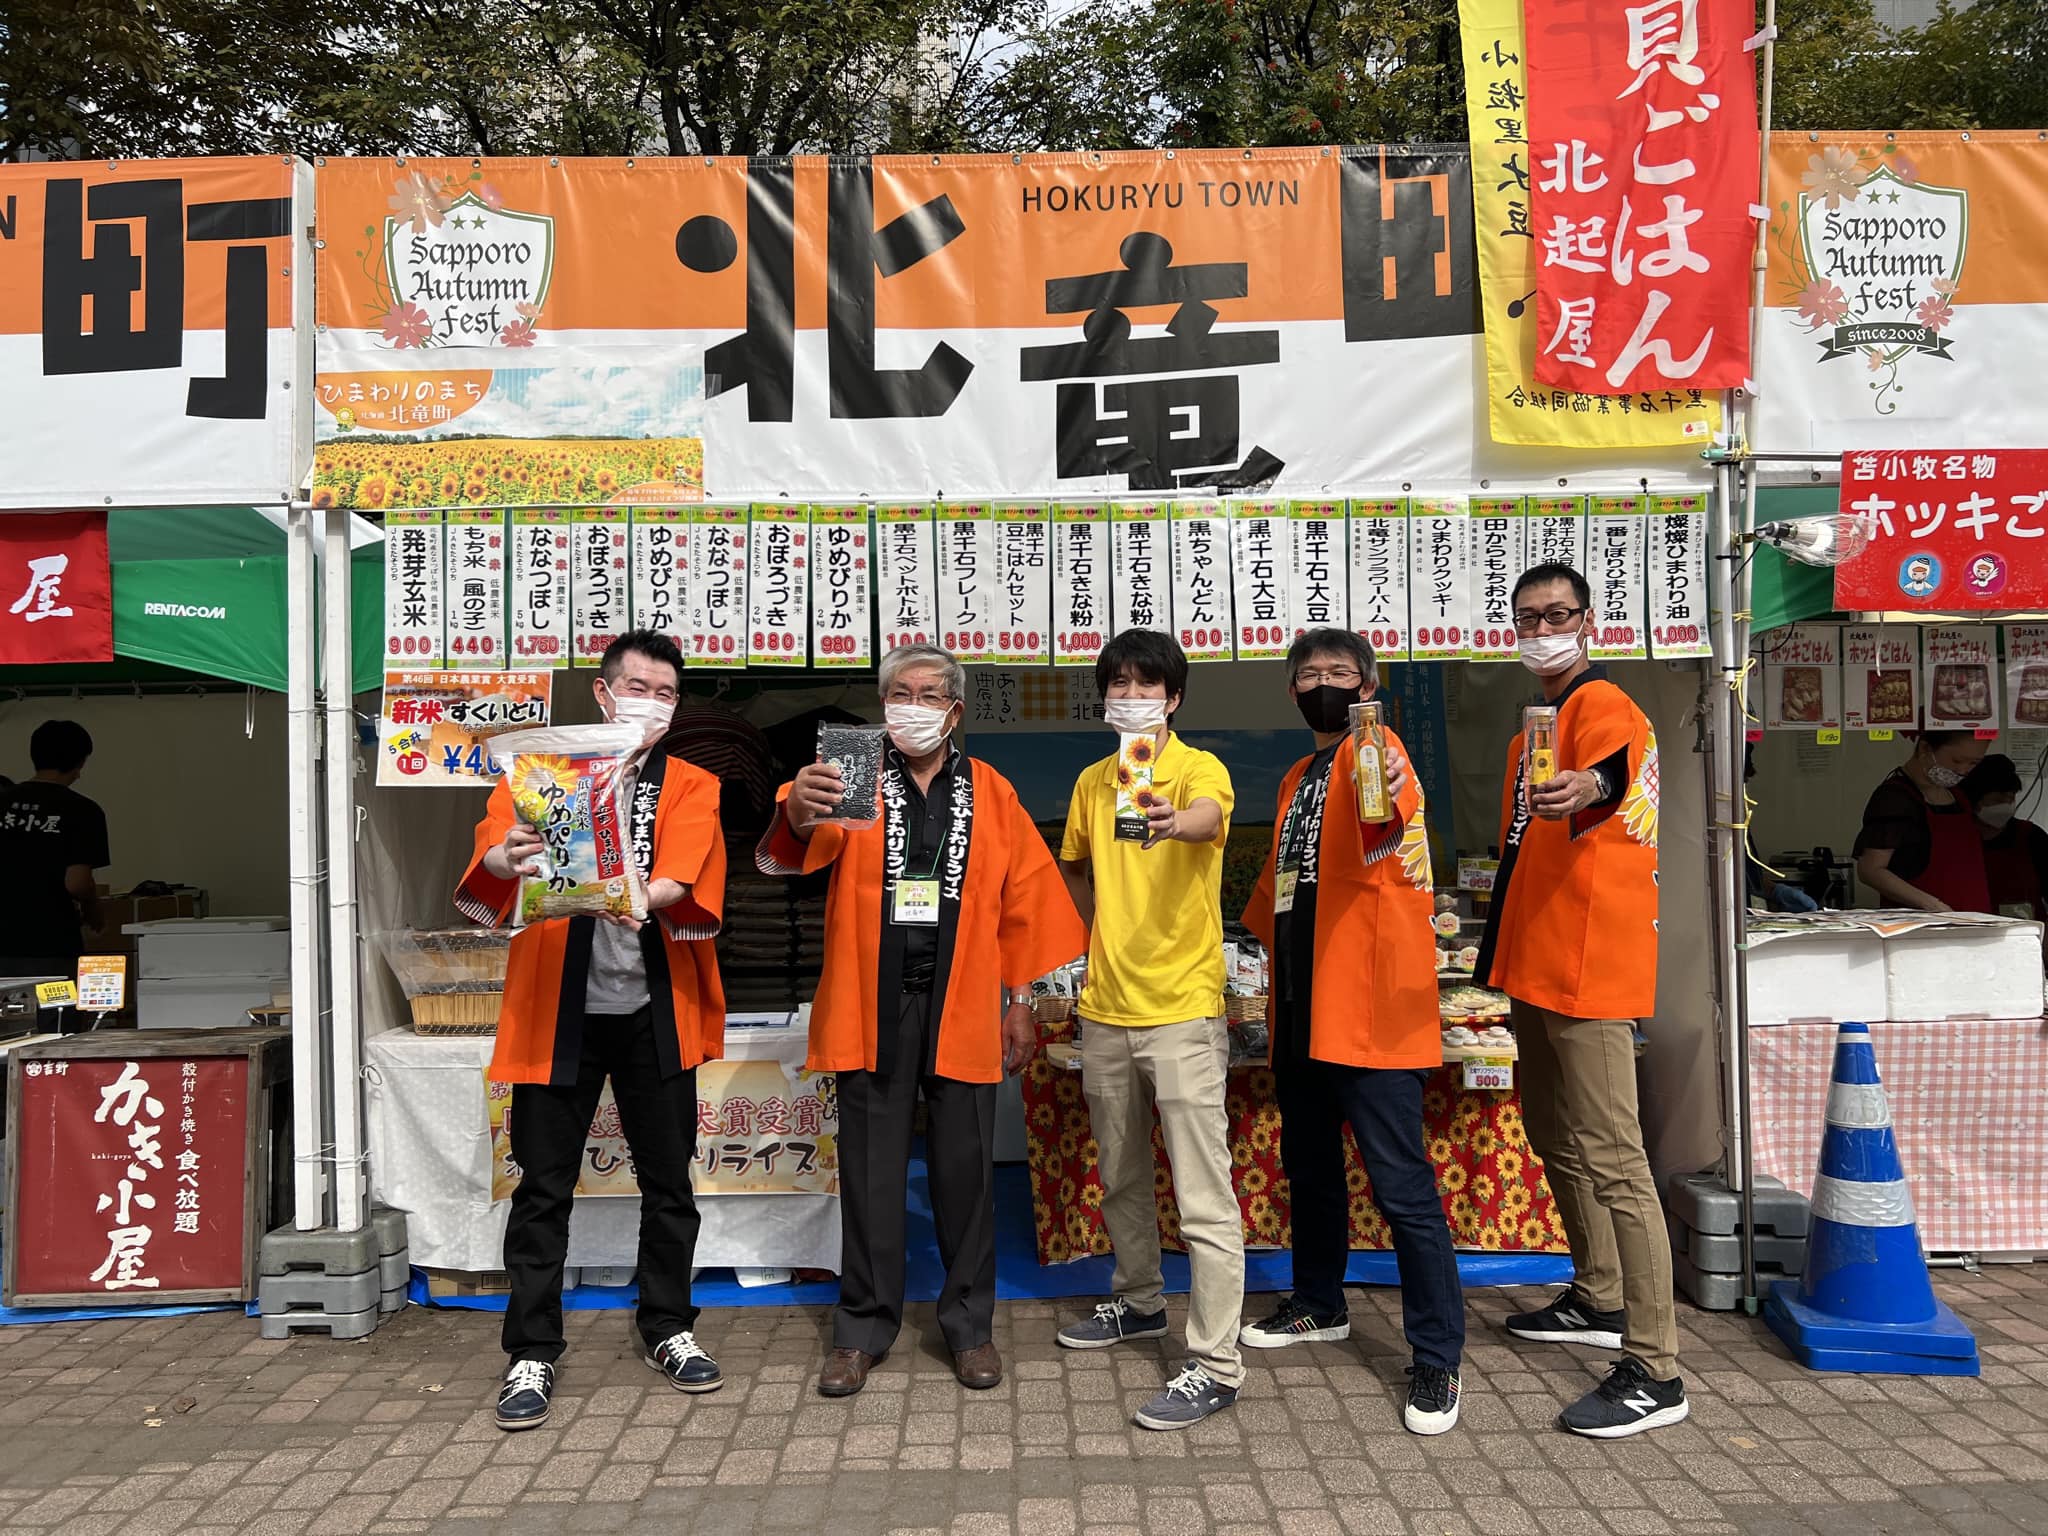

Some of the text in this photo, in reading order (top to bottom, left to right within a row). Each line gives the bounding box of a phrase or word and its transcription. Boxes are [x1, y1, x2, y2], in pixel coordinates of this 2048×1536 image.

[1022, 180, 1300, 213] HOKURYU TOWN
[1822, 212, 1947, 248] Sapporo
[407, 235, 532, 275] Sapporo
[1539, 139, 1608, 369] 北起屋
[1825, 247, 1947, 279] Autumn
[42, 178, 291, 420] 町
[408, 269, 531, 304] Autumn
[1847, 326, 1927, 342] since2008
[324, 379, 482, 402] ひまわりのまち
[390, 404, 453, 425] 北竜町
[1852, 454, 1997, 481] 苫小牧名物
[1850, 490, 2048, 541] ホッキご
[463, 526, 487, 569] もち米
[1025, 522, 1045, 567] 黒千石
[9, 553, 73, 622] 屋
[402, 528, 428, 628] 発芽玄米
[529, 526, 552, 630] ななつぼし
[587, 525, 612, 629] おぼろづき
[649, 525, 673, 630] ゆめぴりか
[706, 525, 731, 629] ななつぼし
[766, 523, 791, 628] おぼろづき
[828, 525, 852, 630] ゆめぴりか
[953, 521, 977, 626] 黒千石フレーク
[1006, 522, 1025, 627] 豆ごはんセット
[1069, 523, 1094, 628] 黒千石きな粉
[1128, 521, 1154, 626] 黒千石きな粉
[1187, 520, 1214, 624] 黒ちゃんどん
[1248, 519, 1277, 621] 黒千石大豆
[1305, 520, 1331, 623] 黒千石大豆
[1431, 518, 1453, 618] ひまわりクッキー
[1484, 518, 1508, 624] 田からもちおかき
[1603, 519, 1629, 622] 一番しぼりひまわり油
[1664, 514, 1691, 620] 燦燦ひまわり油
[144, 602, 226, 619] RENTACOM
[388, 635, 433, 655] 900
[451, 635, 494, 655] 440
[693, 634, 736, 654] 780
[753, 632, 796, 651] 880
[820, 635, 857, 655] 980
[944, 631, 986, 650] 350
[999, 630, 1040, 650] 500
[1059, 631, 1102, 653] 1,000
[1180, 628, 1223, 649] 500
[1241, 625, 1283, 646] 500
[1417, 625, 1461, 647] 900
[1473, 628, 1516, 648] 300
[1591, 625, 1636, 648] 1,000
[1653, 624, 1699, 647] 1,000
[391, 699, 546, 725] 新米 すくいとり
[997, 672, 1016, 724] あかるい
[400, 758, 424, 770] 1回
[0, 811, 62, 835] き小屋
[539, 781, 578, 894] ゆめぴりか
[1475, 1074, 1500, 1087] 500
[173, 1062, 202, 1234] 殻付かき焼き 食べ放題
[90, 1061, 165, 1291] かき小屋
